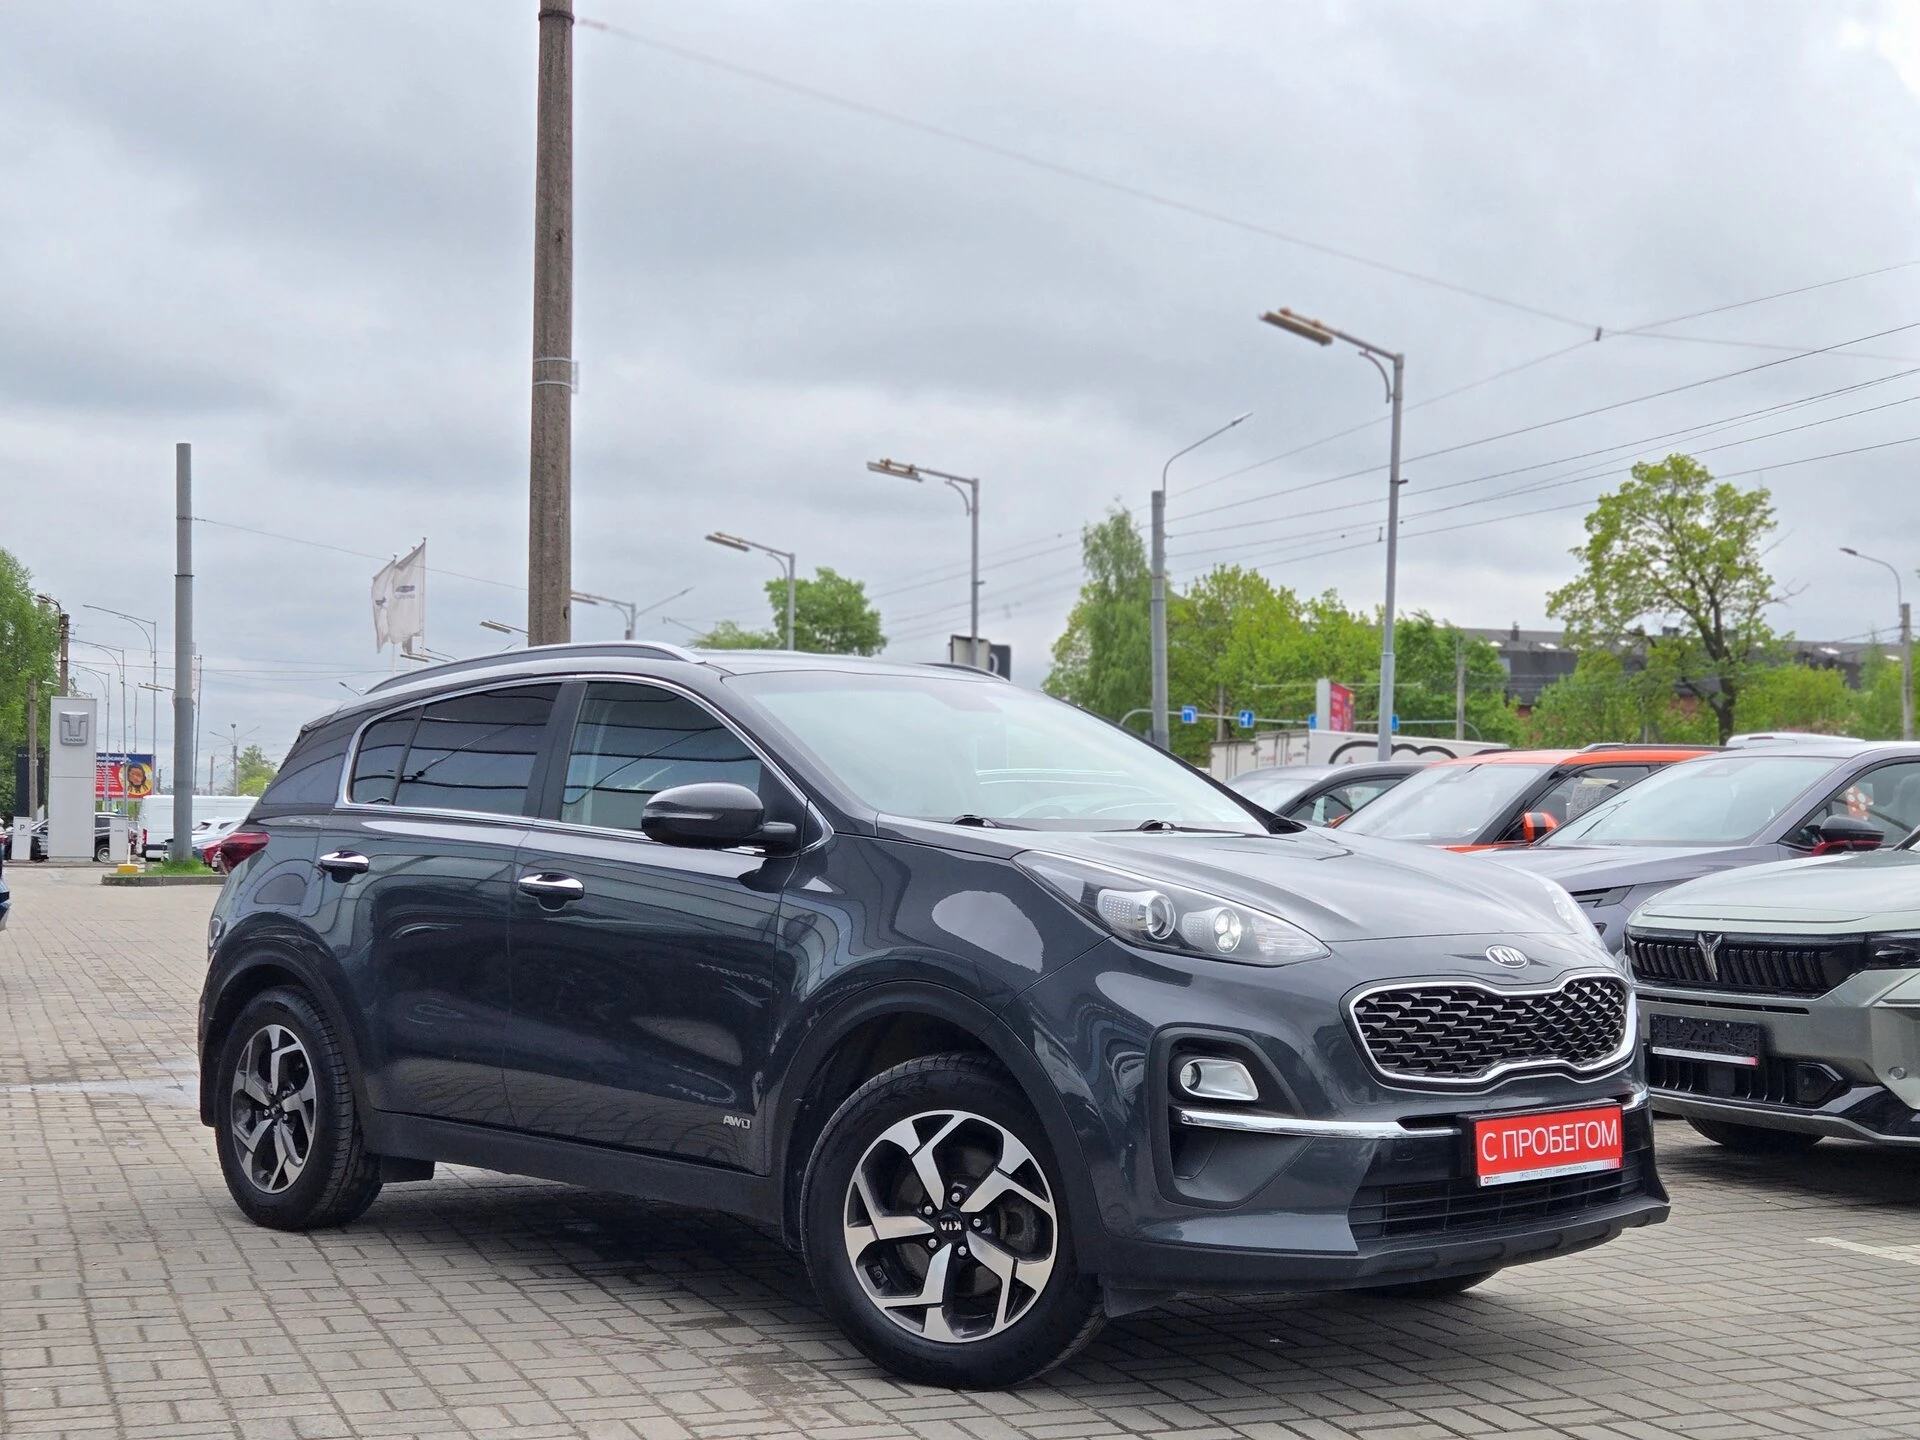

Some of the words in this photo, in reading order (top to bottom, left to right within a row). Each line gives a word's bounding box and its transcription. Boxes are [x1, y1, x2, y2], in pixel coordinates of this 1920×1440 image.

[723, 1115, 751, 1129] AWD
[1482, 1132, 1498, 1161] С
[1502, 1119, 1618, 1159] ПРОБЕГОМ
[940, 1220, 962, 1231] KIA
